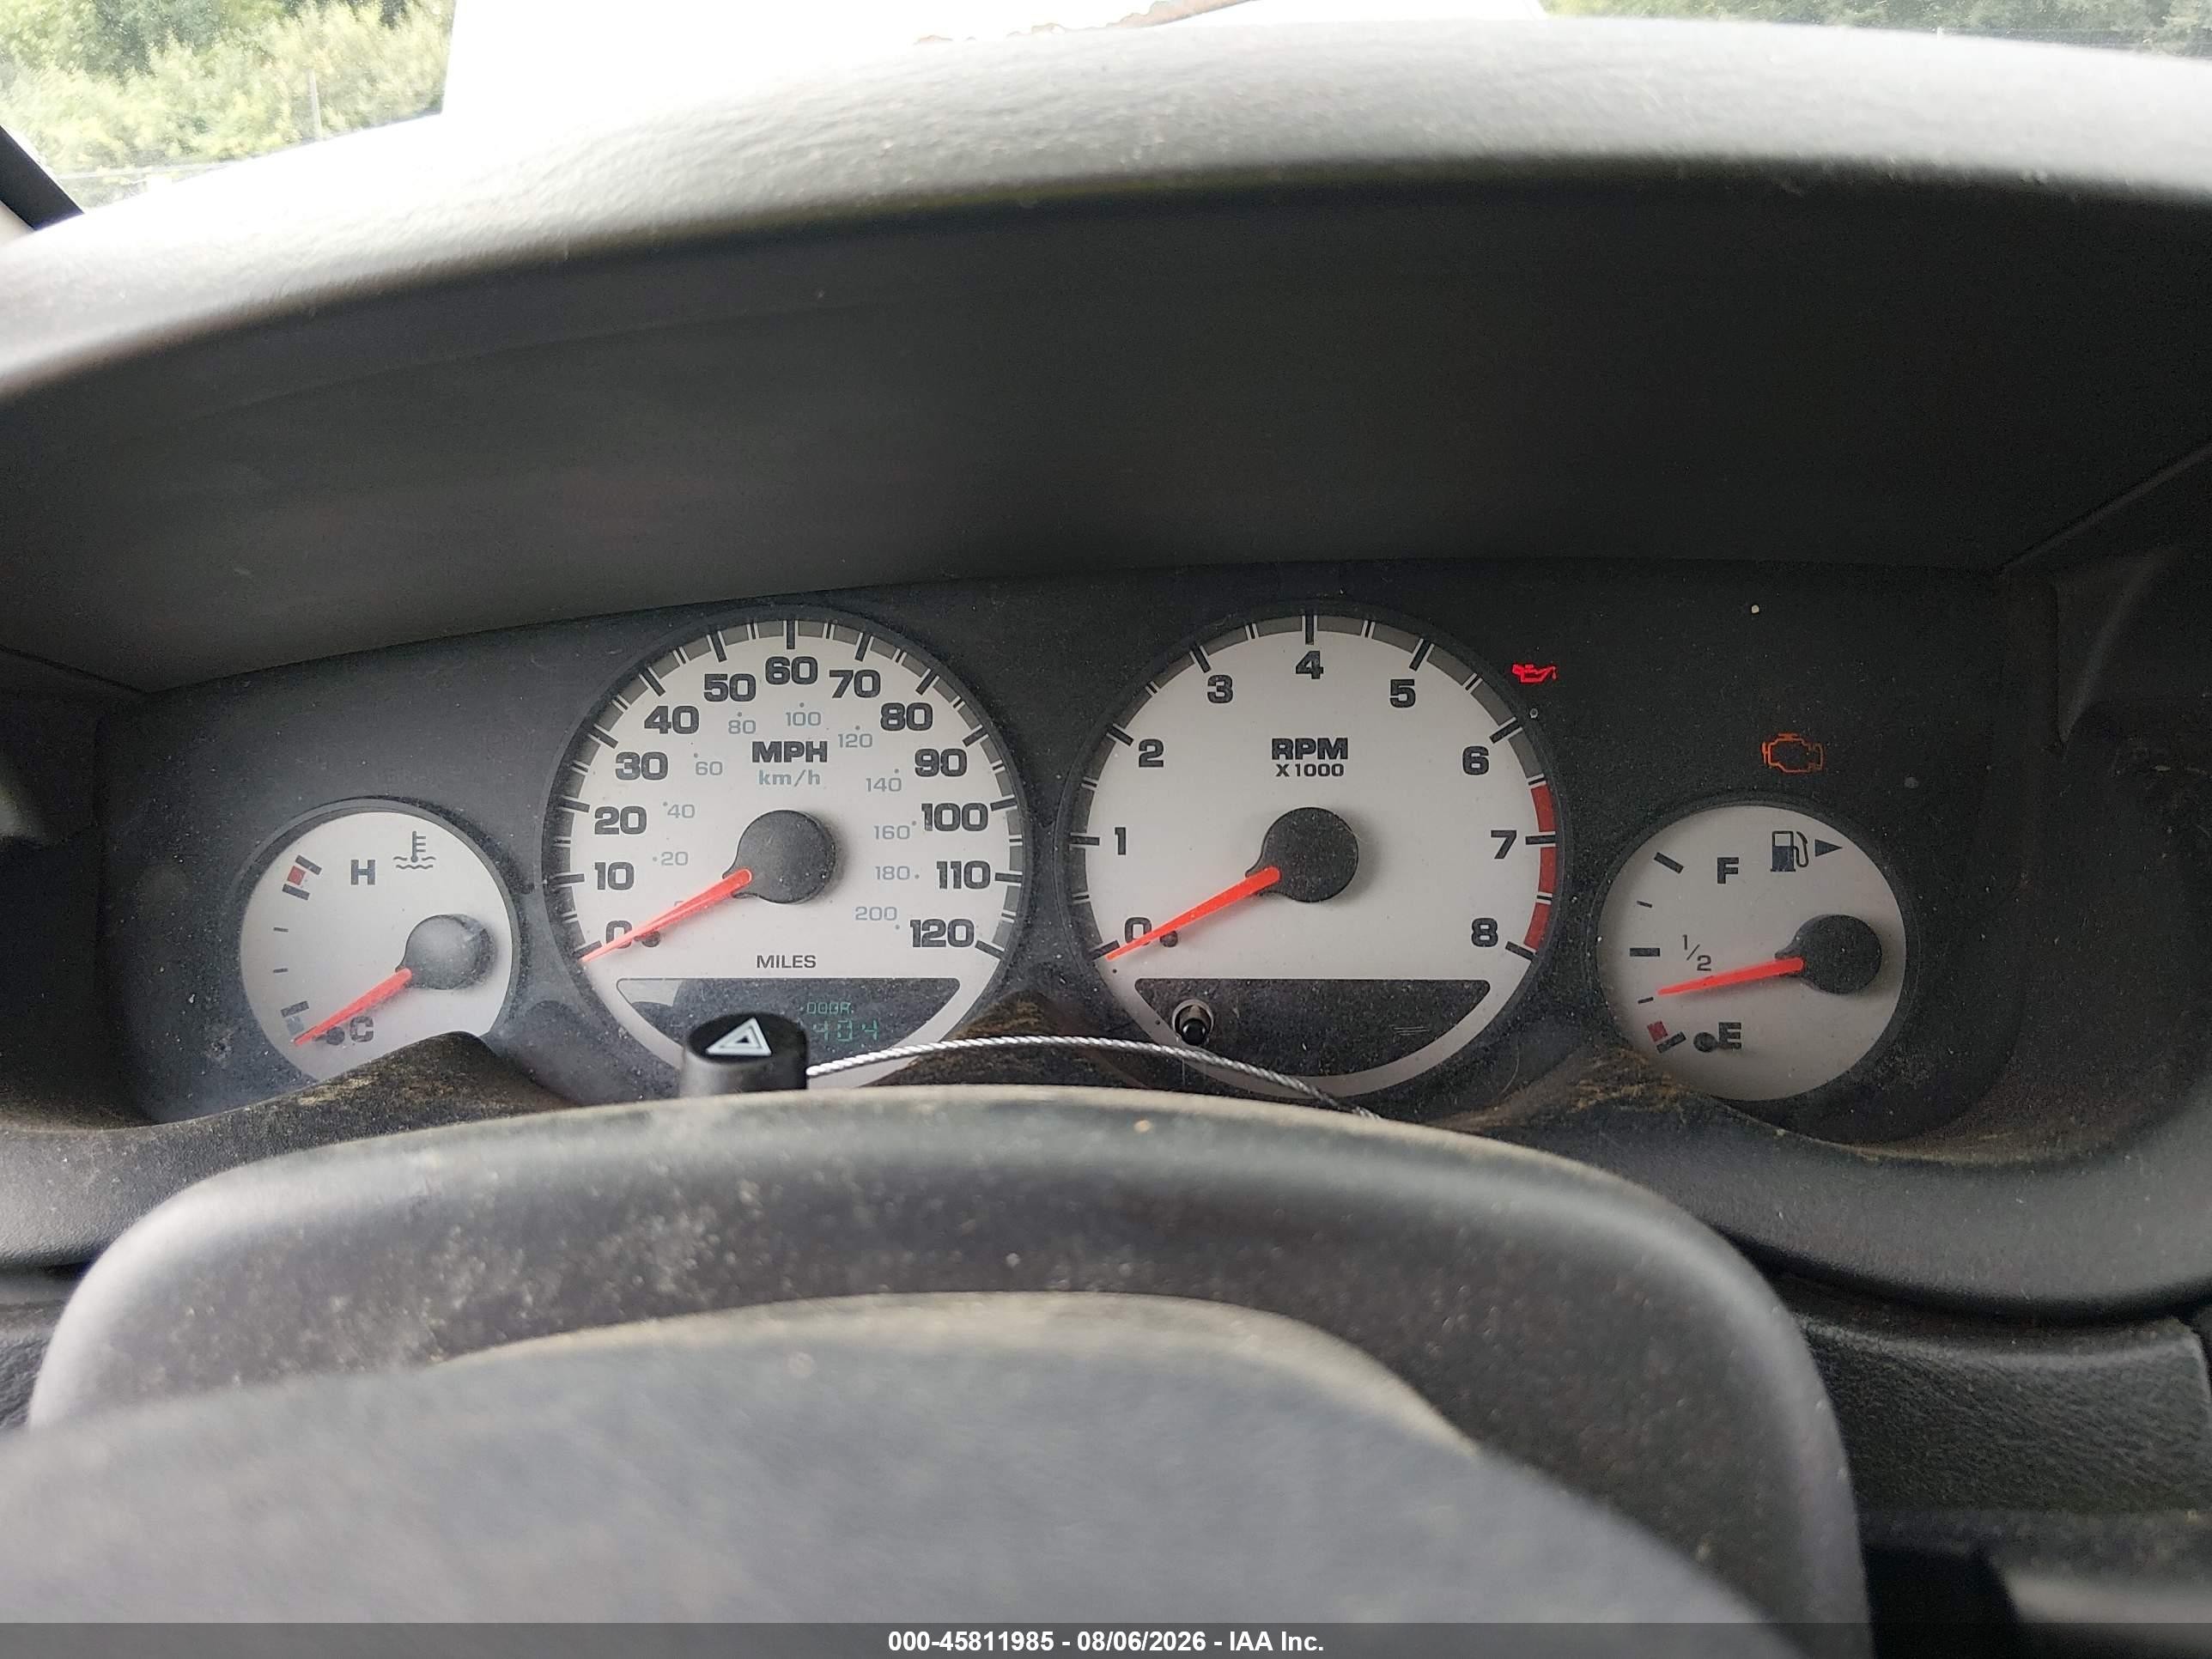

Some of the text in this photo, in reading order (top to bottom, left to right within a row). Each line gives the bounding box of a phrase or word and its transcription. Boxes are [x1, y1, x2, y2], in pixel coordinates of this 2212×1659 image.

[765, 656, 817, 684] 60
[1295, 651, 1323, 679] 4
[704, 673, 756, 702] 50
[830, 669, 881, 698] 70
[1207, 675, 1234, 703] 3
[1389, 679, 1416, 708] 5
[644, 706, 699, 734] 40
[728, 720, 756, 734] 80
[786, 712, 821, 726] 100
[881, 702, 933, 732] 80
[752, 741, 828, 763] MPH
[838, 733, 872, 748] 120
[1138, 738, 1164, 768] 2
[1271, 738, 1348, 760] RPM
[615, 751, 668, 781] 30
[695, 761, 723, 775] 60
[915, 748, 968, 777] 90
[1462, 746, 1490, 775] 6
[758, 769, 821, 787] km/h
[866, 778, 902, 793] 140
[594, 805, 647, 835] 20
[667, 804, 696, 818] 40
[921, 803, 988, 831] 100
[874, 825, 910, 840] 160
[1115, 827, 1126, 855] 1
[1490, 830, 1517, 860] 7
[350, 860, 375, 884] H
[660, 852, 689, 866] 20
[876, 866, 910, 880] 180
[1717, 858, 1739, 884] F
[594, 861, 635, 890] 10
[936, 860, 991, 889] 110
[855, 907, 897, 921] 200
[605, 920, 633, 949] 0
[909, 919, 975, 948] 120
[1124, 917, 1152, 946] 0
[1471, 919, 1498, 947] 8
[756, 954, 817, 969] MILES
[349, 1016, 374, 1042] C
[1718, 1022, 1741, 1048] E
